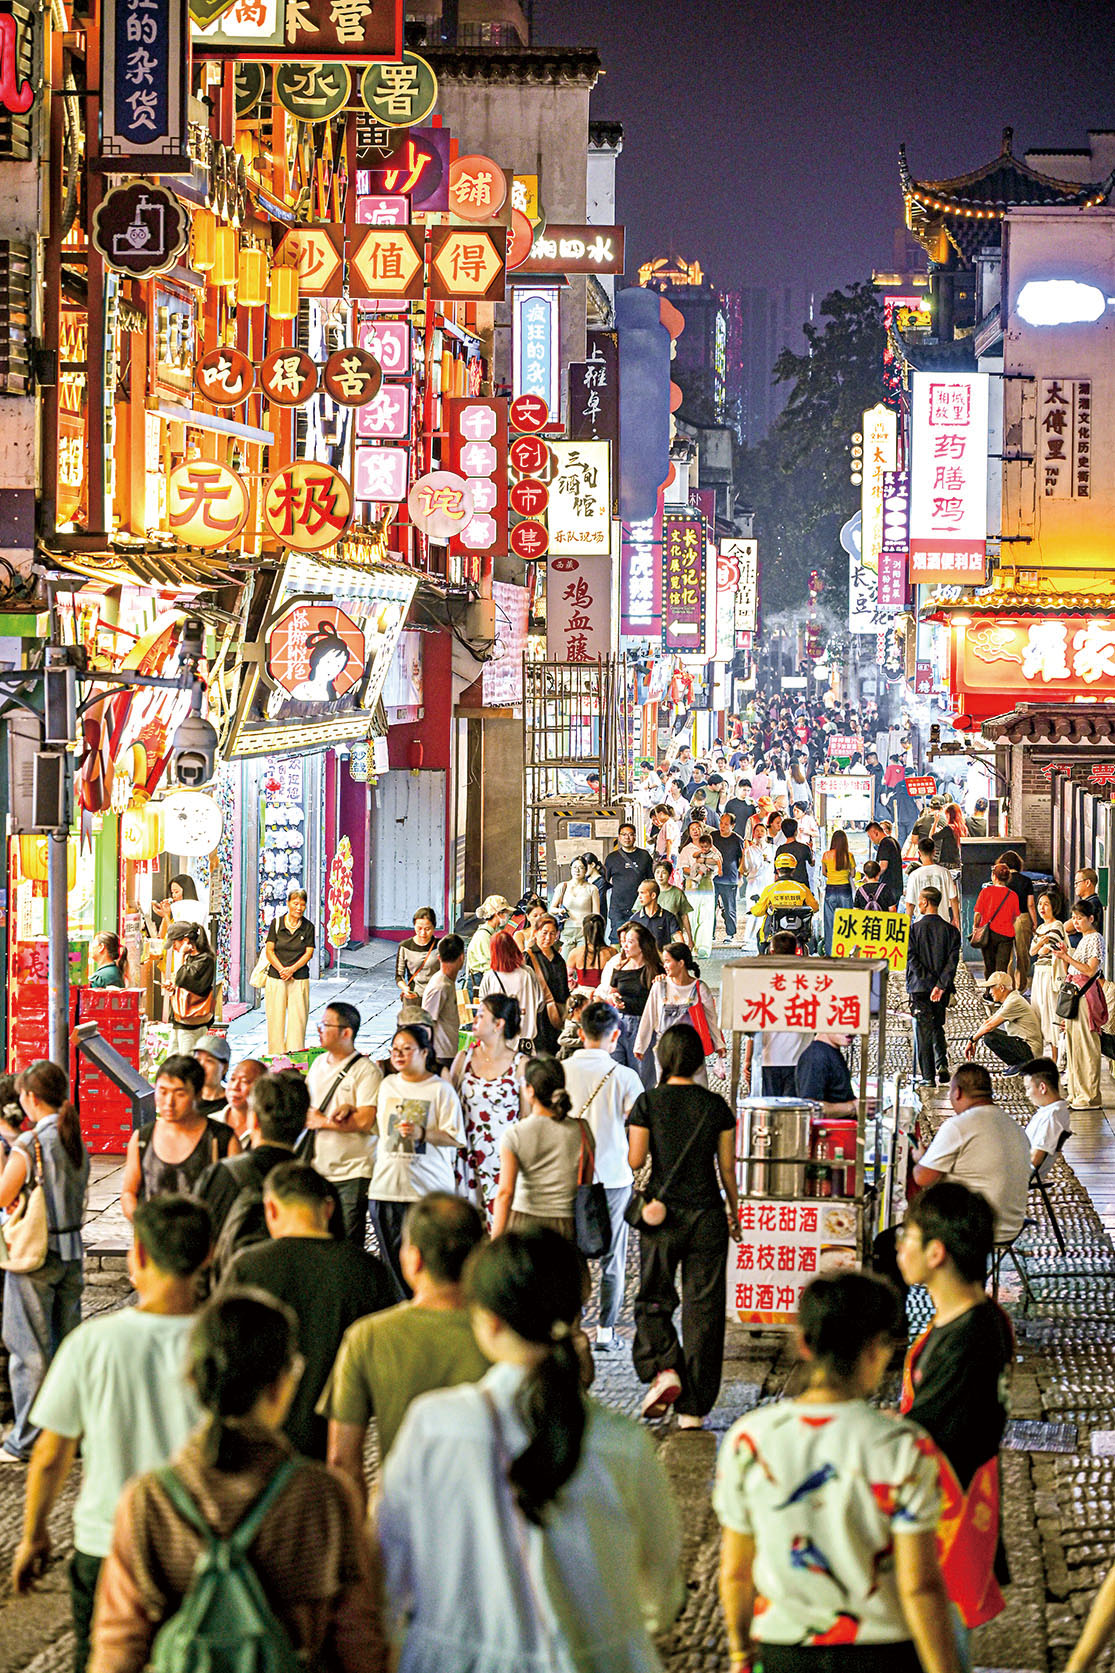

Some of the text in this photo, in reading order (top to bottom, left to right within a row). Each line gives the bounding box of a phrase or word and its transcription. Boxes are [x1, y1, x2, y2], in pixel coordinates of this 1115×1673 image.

[235, 63, 419, 116] 丞署
[450, 171, 493, 206] 铺
[201, 357, 371, 399] 吃得苦
[1042, 381, 1070, 461] 太傅里
[515, 398, 543, 554] 文创市集
[931, 434, 968, 522] 药膳鸡
[170, 468, 348, 537] 无极
[418, 485, 466, 521] 诧
[553, 529, 605, 544] 乐队现场
[669, 529, 682, 606] 文化展览馆
[680, 527, 699, 606] 长沙记忆
[912, 552, 983, 571] 烟酒便利店
[561, 576, 598, 664] 鸡血藤
[836, 913, 908, 944] 冰箱贴
[769, 972, 834, 991] 老长沙
[742, 993, 862, 1030] 冰甜酒
[738, 1205, 818, 1233] 桂花甜酒
[735, 1244, 817, 1272] 荔枝甜酒
[735, 1283, 806, 1311] 甜酒冲
